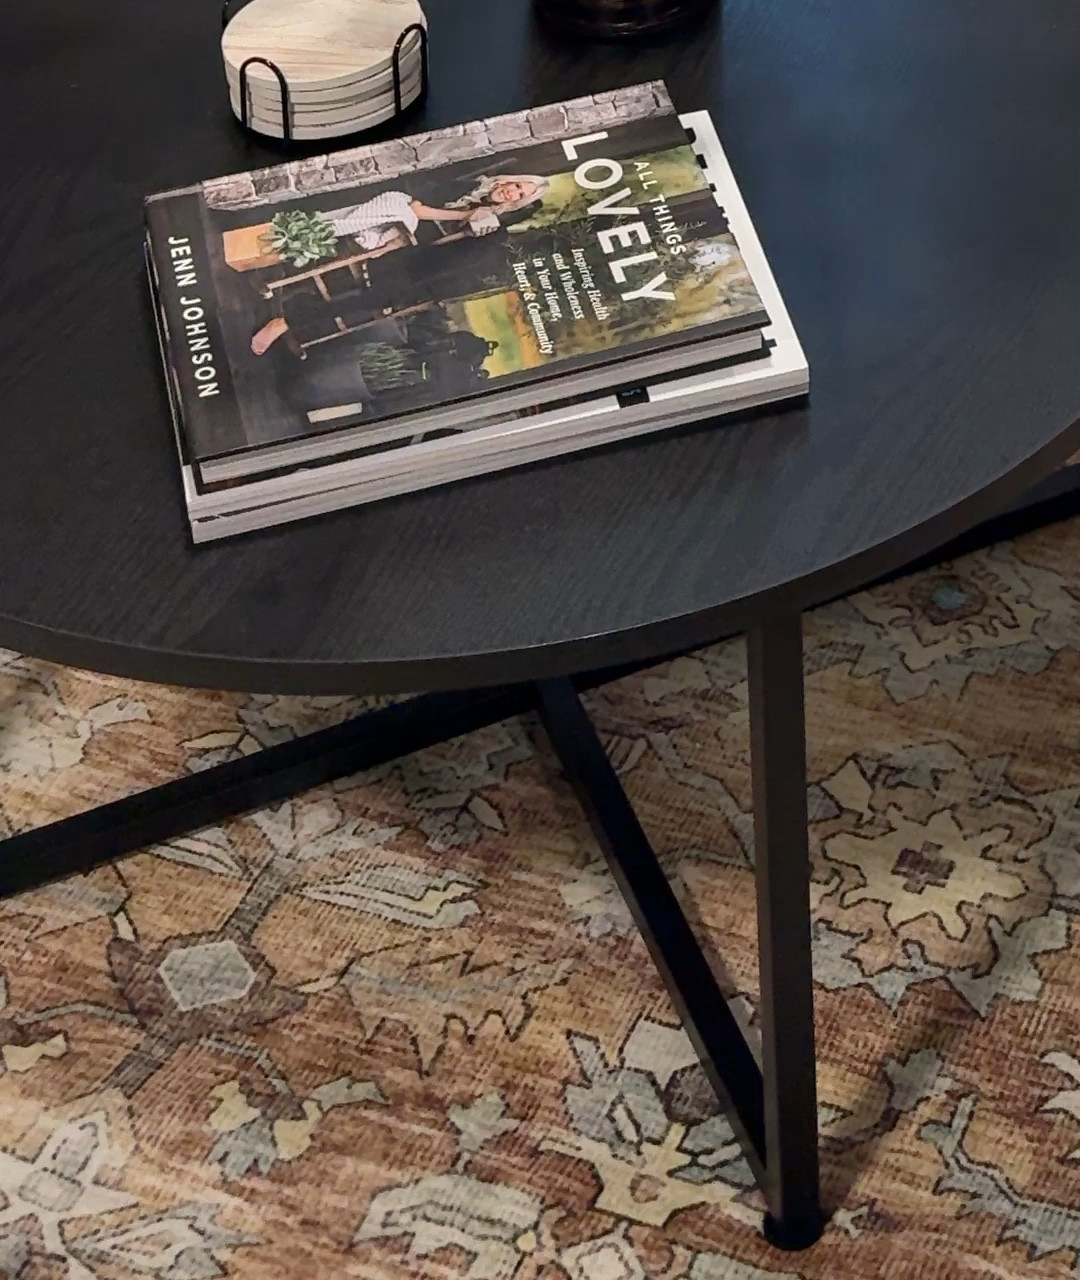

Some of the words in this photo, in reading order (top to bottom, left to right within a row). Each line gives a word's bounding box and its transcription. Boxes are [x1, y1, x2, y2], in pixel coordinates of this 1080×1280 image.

[561, 131, 676, 301] LOVELY
[633, 161, 658, 190] ALL
[649, 194, 687, 255] THINGS
[168, 236, 198, 288] JENN
[512, 262, 531, 292] Heart,
[532, 257, 546, 268] in
[537, 268, 553, 291] Your
[552, 253, 570, 271] and
[571, 247, 595, 289] Inspiring
[587, 289, 610, 321] Health
[523, 291, 537, 301] &
[544, 292, 562, 322] Home,
[560, 271, 585, 320] Wholeness
[180, 296, 221, 398] JOHNSON
[527, 302, 555, 354] Community
